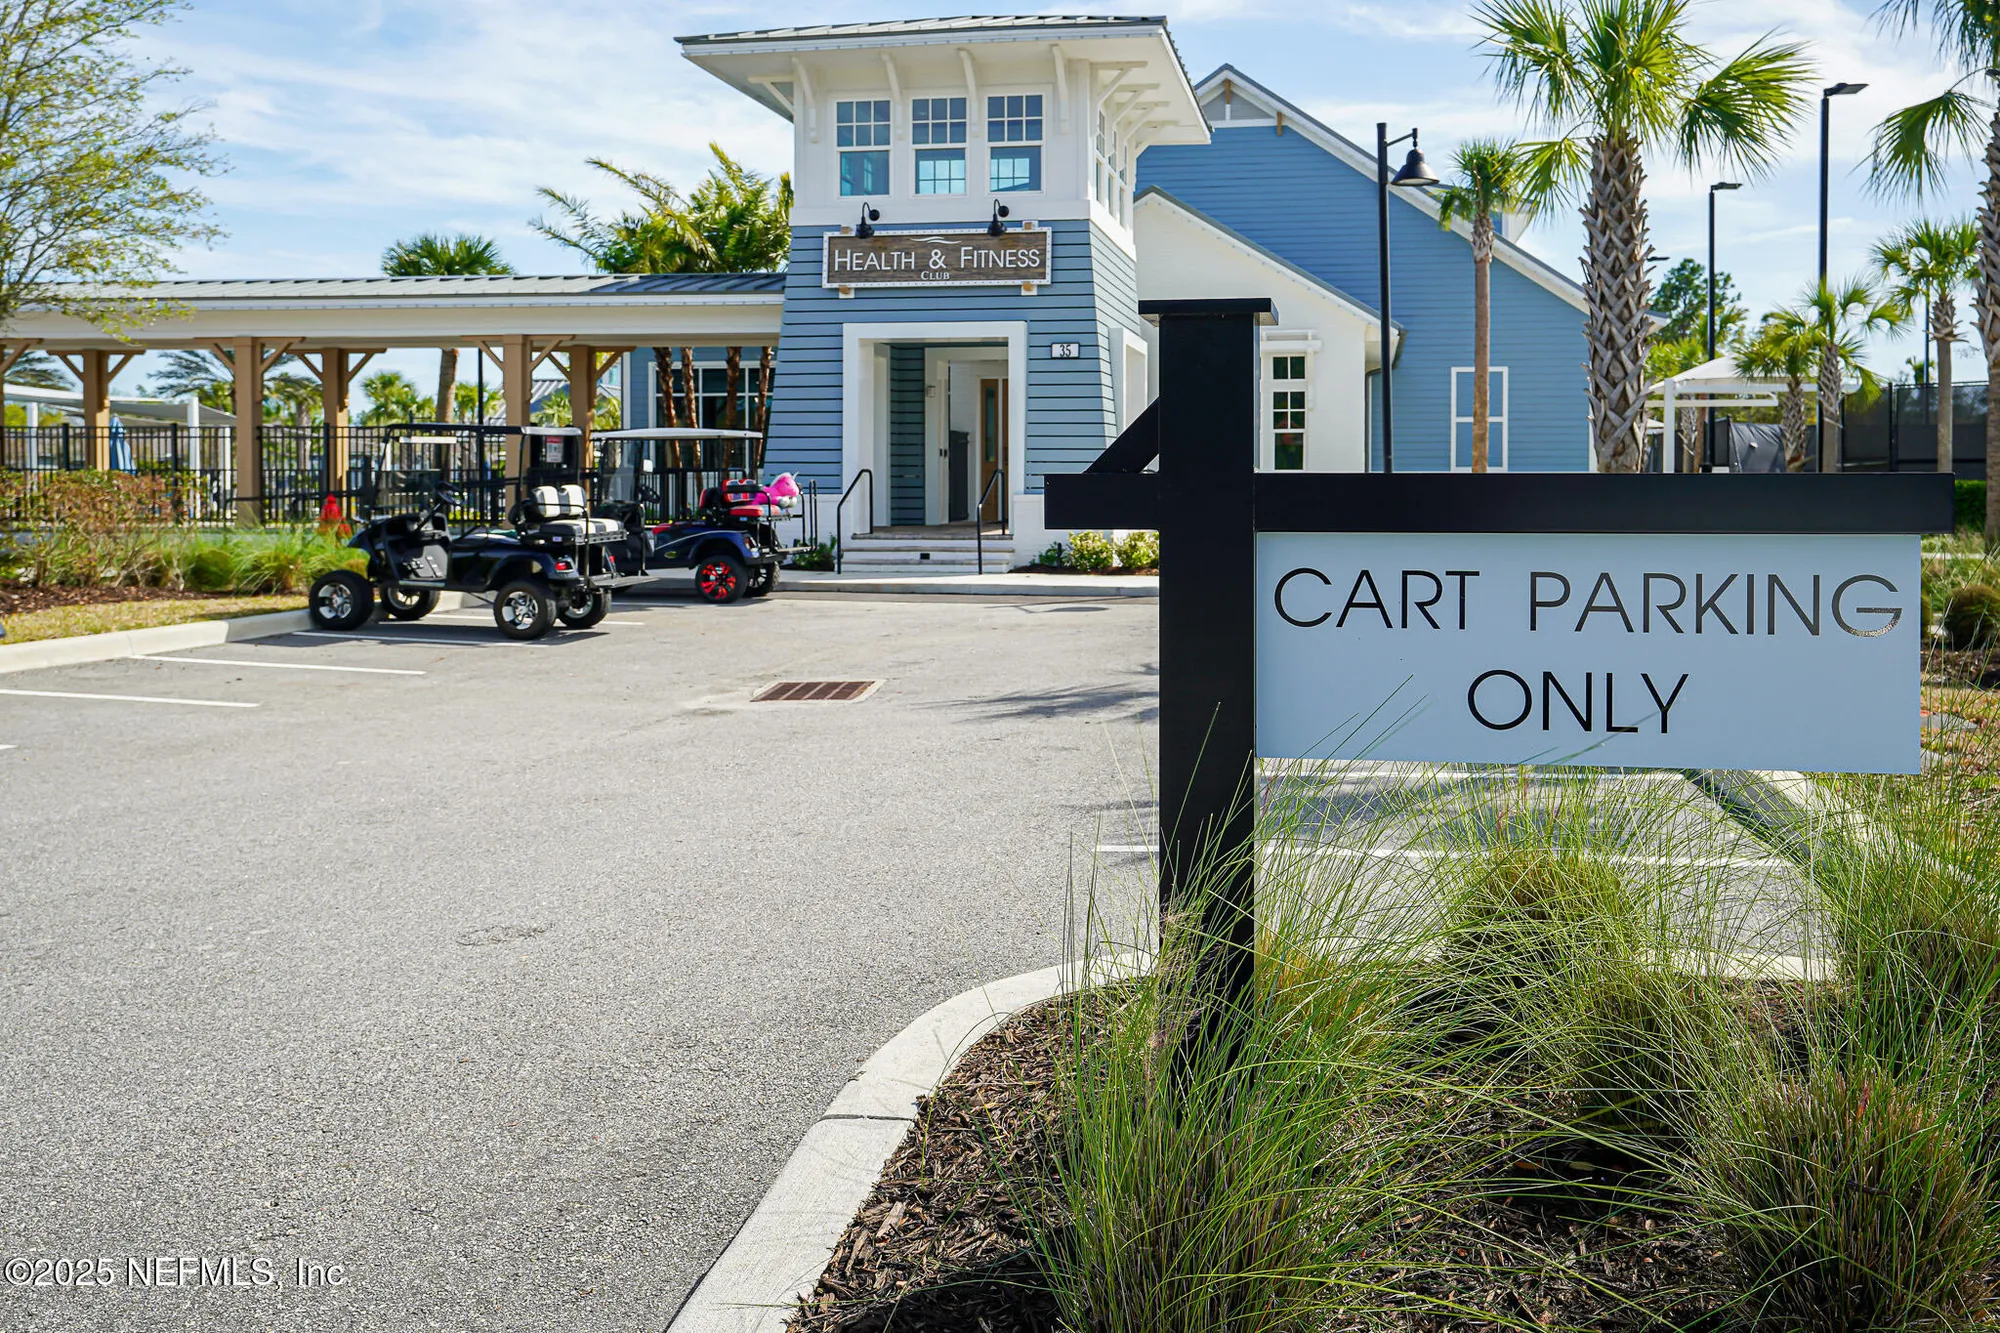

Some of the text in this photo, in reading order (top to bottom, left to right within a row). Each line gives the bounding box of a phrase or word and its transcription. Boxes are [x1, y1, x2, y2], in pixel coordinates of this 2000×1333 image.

[834, 246, 1040, 271] HEALTH & FITNESS
[920, 270, 950, 280] CLUB
[1059, 343, 1072, 358] 35
[1274, 568, 1903, 637] CART PARKING
[1467, 669, 1689, 734] ONLY
